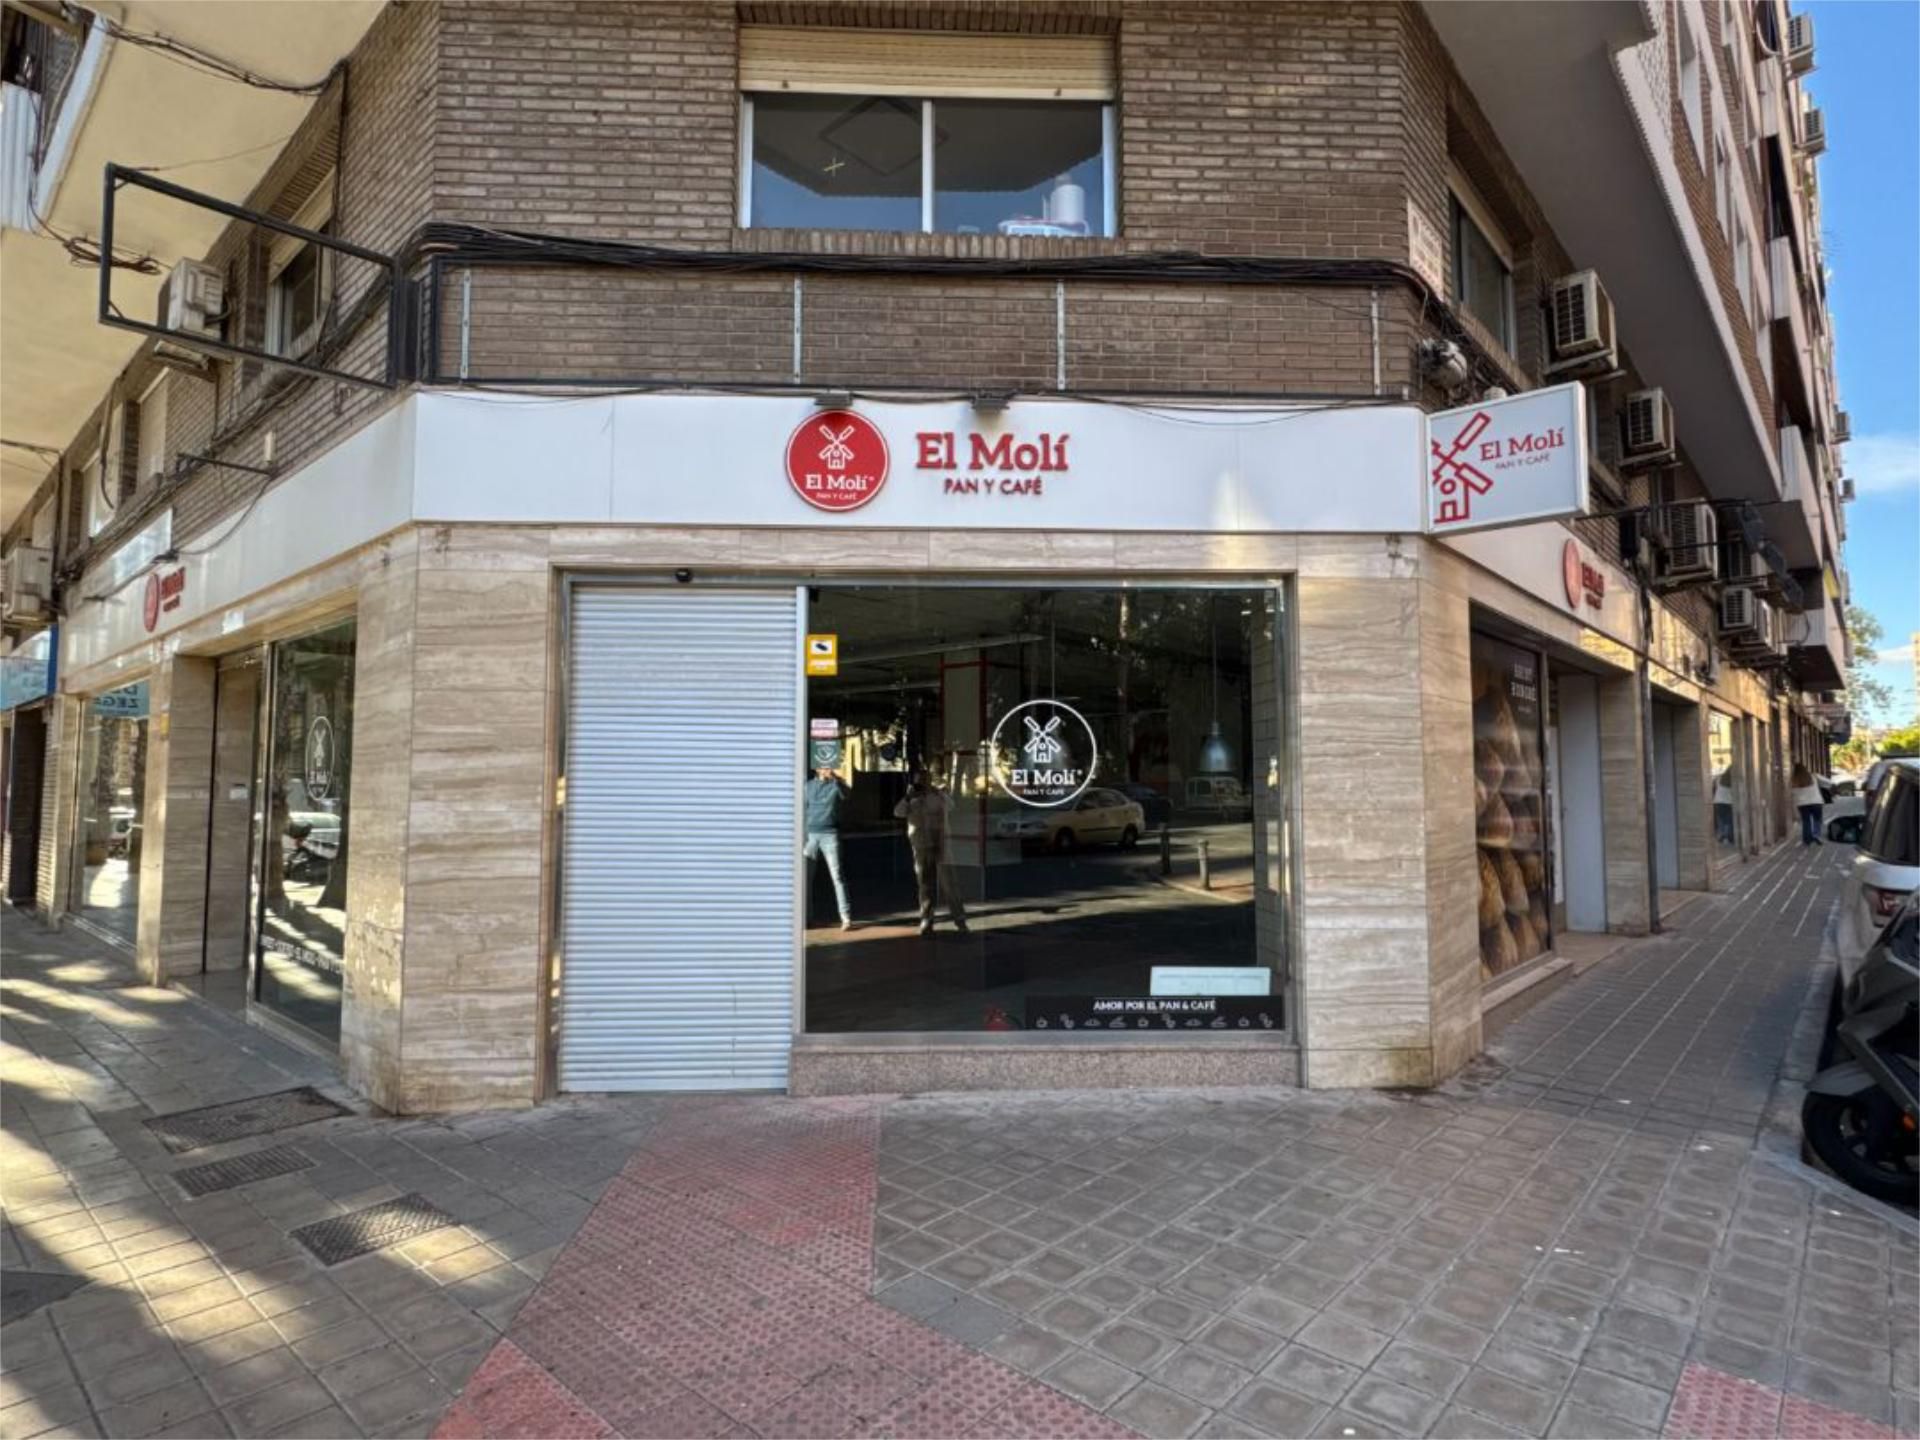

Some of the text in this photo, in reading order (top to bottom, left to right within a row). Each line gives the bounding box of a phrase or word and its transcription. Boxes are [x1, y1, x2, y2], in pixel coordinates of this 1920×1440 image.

[915, 432, 1069, 471] El Molí
[1480, 426, 1565, 462] El Molí
[805, 474, 868, 491] El Molí
[944, 475, 1043, 496] PAN Y CAFÉ
[1011, 768, 1076, 785] El Molí
[1093, 1000, 1124, 1011] AMOR
[1125, 1000, 1145, 1011] POR
[1147, 1000, 1157, 1011] EL
[1159, 1000, 1180, 1011] PAN
[1190, 998, 1216, 1011] CAFÉ
